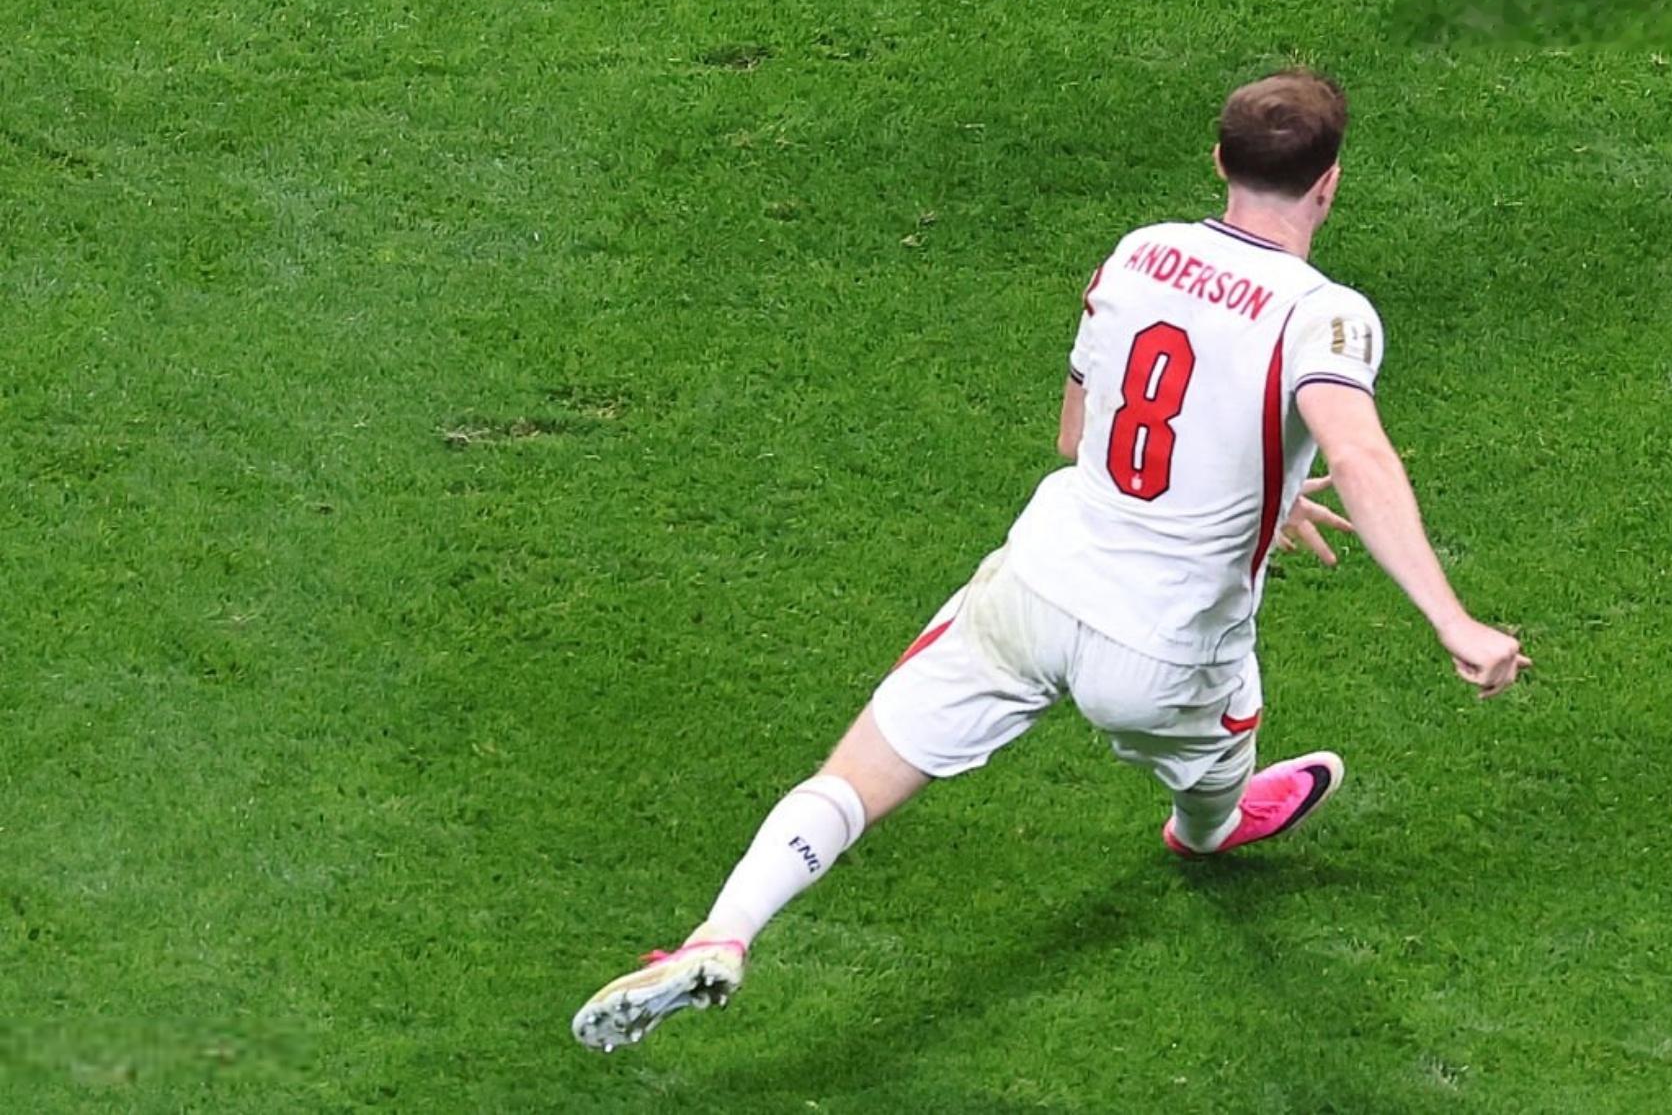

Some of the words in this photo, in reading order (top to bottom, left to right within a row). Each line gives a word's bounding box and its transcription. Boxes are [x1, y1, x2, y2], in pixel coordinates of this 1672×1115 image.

[1123, 242, 1274, 321] ANDERSON
[1106, 321, 1196, 502] 8
[788, 835, 822, 874] ENG
